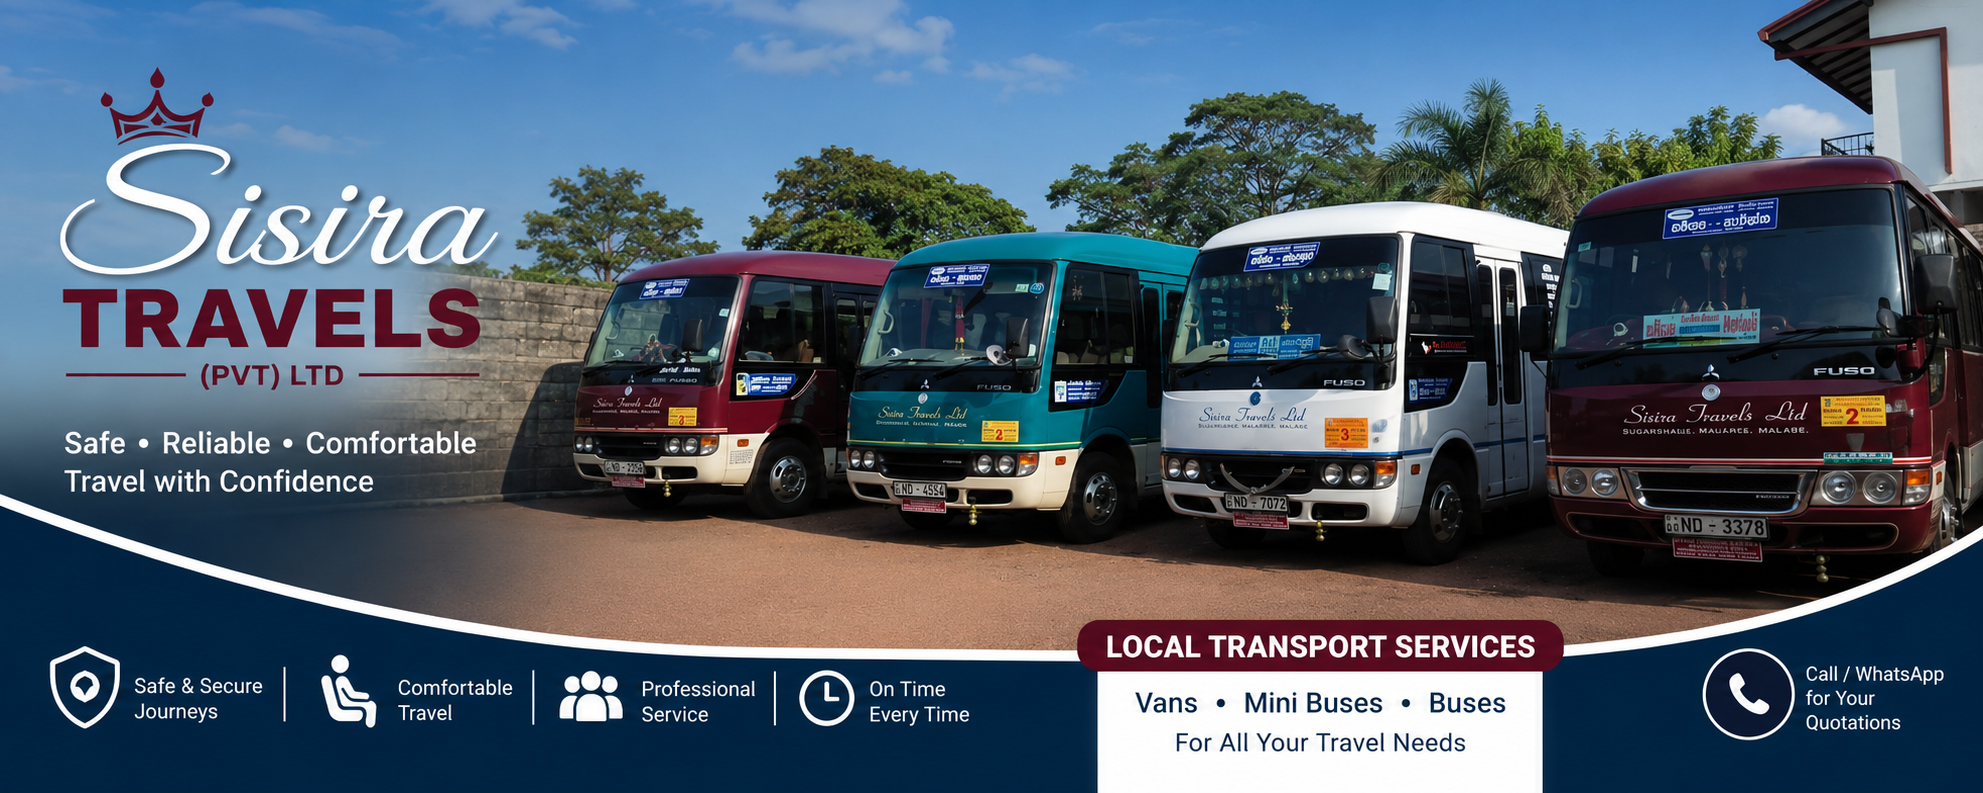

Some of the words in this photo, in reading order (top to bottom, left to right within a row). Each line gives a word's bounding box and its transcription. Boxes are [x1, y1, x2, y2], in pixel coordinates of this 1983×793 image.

[1813, 366, 1875, 376] FUSO
[1624, 403, 1678, 424] Sisira
[1686, 402, 1753, 422] Travels
[1765, 400, 1808, 422] Ltd
[1846, 408, 1859, 424] 2
[996, 429, 1003, 440] 2
[1340, 428, 1350, 441] 3
[902, 484, 913, 494] ND
[1234, 496, 1247, 508] ND
[1260, 497, 1286, 510] 7072
[1681, 517, 1702, 533] ND
[1722, 519, 1764, 536] 3378
